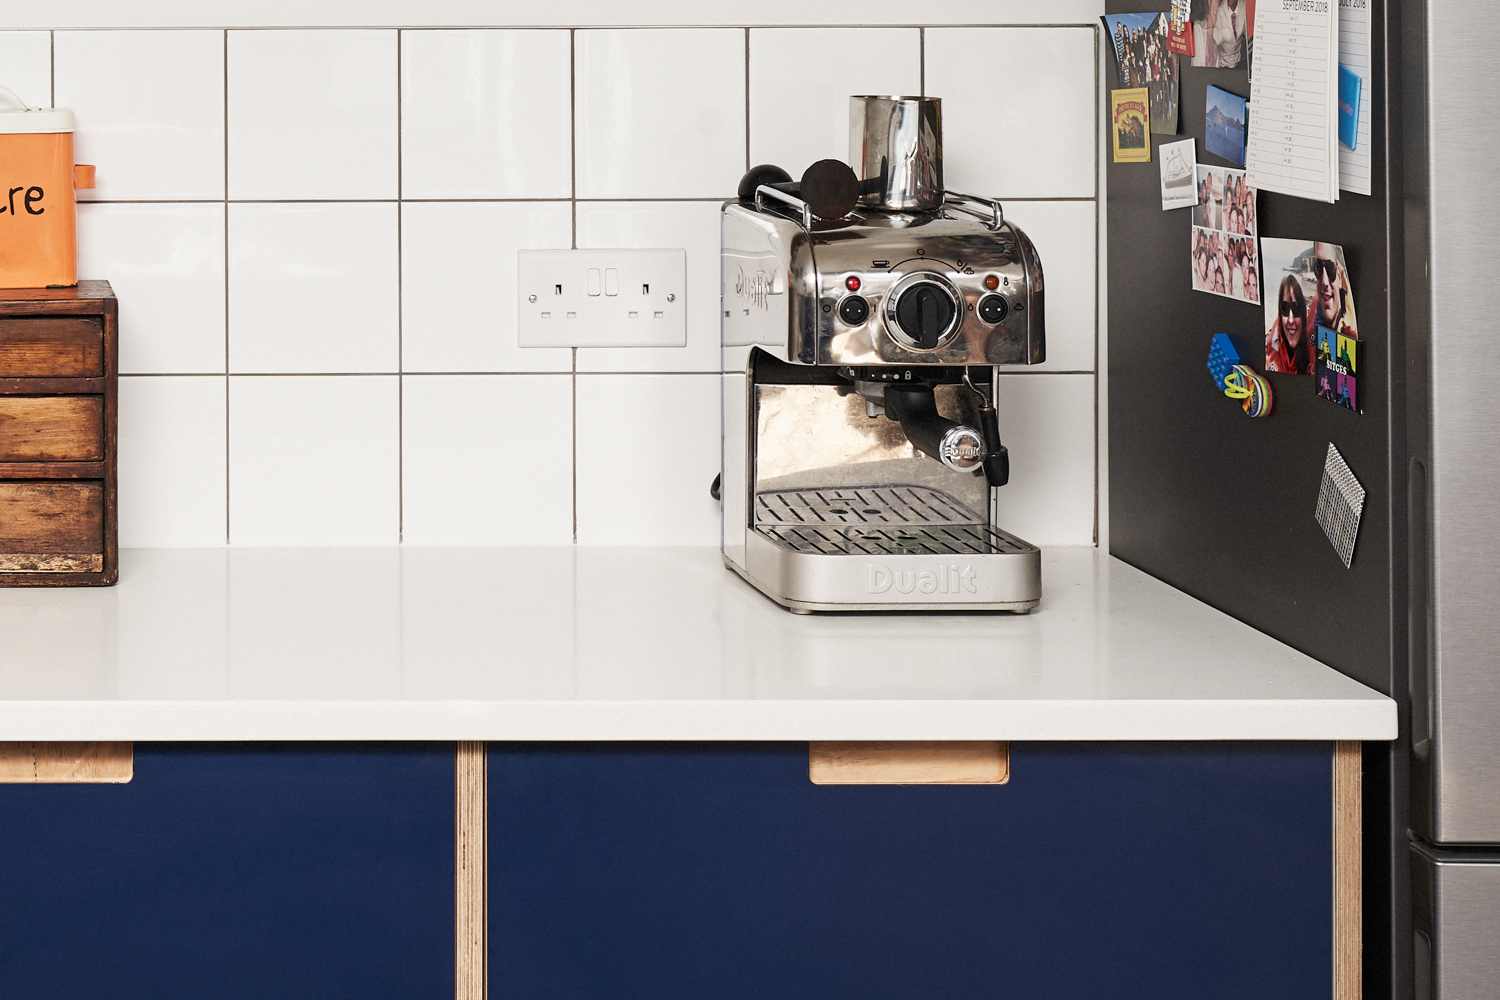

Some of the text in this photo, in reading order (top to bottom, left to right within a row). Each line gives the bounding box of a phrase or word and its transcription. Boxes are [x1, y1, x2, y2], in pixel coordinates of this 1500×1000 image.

[1315, 1, 1329, 13] 2018
[1326, 359, 1348, 376] SITGES
[868, 563, 977, 595] Dualit
